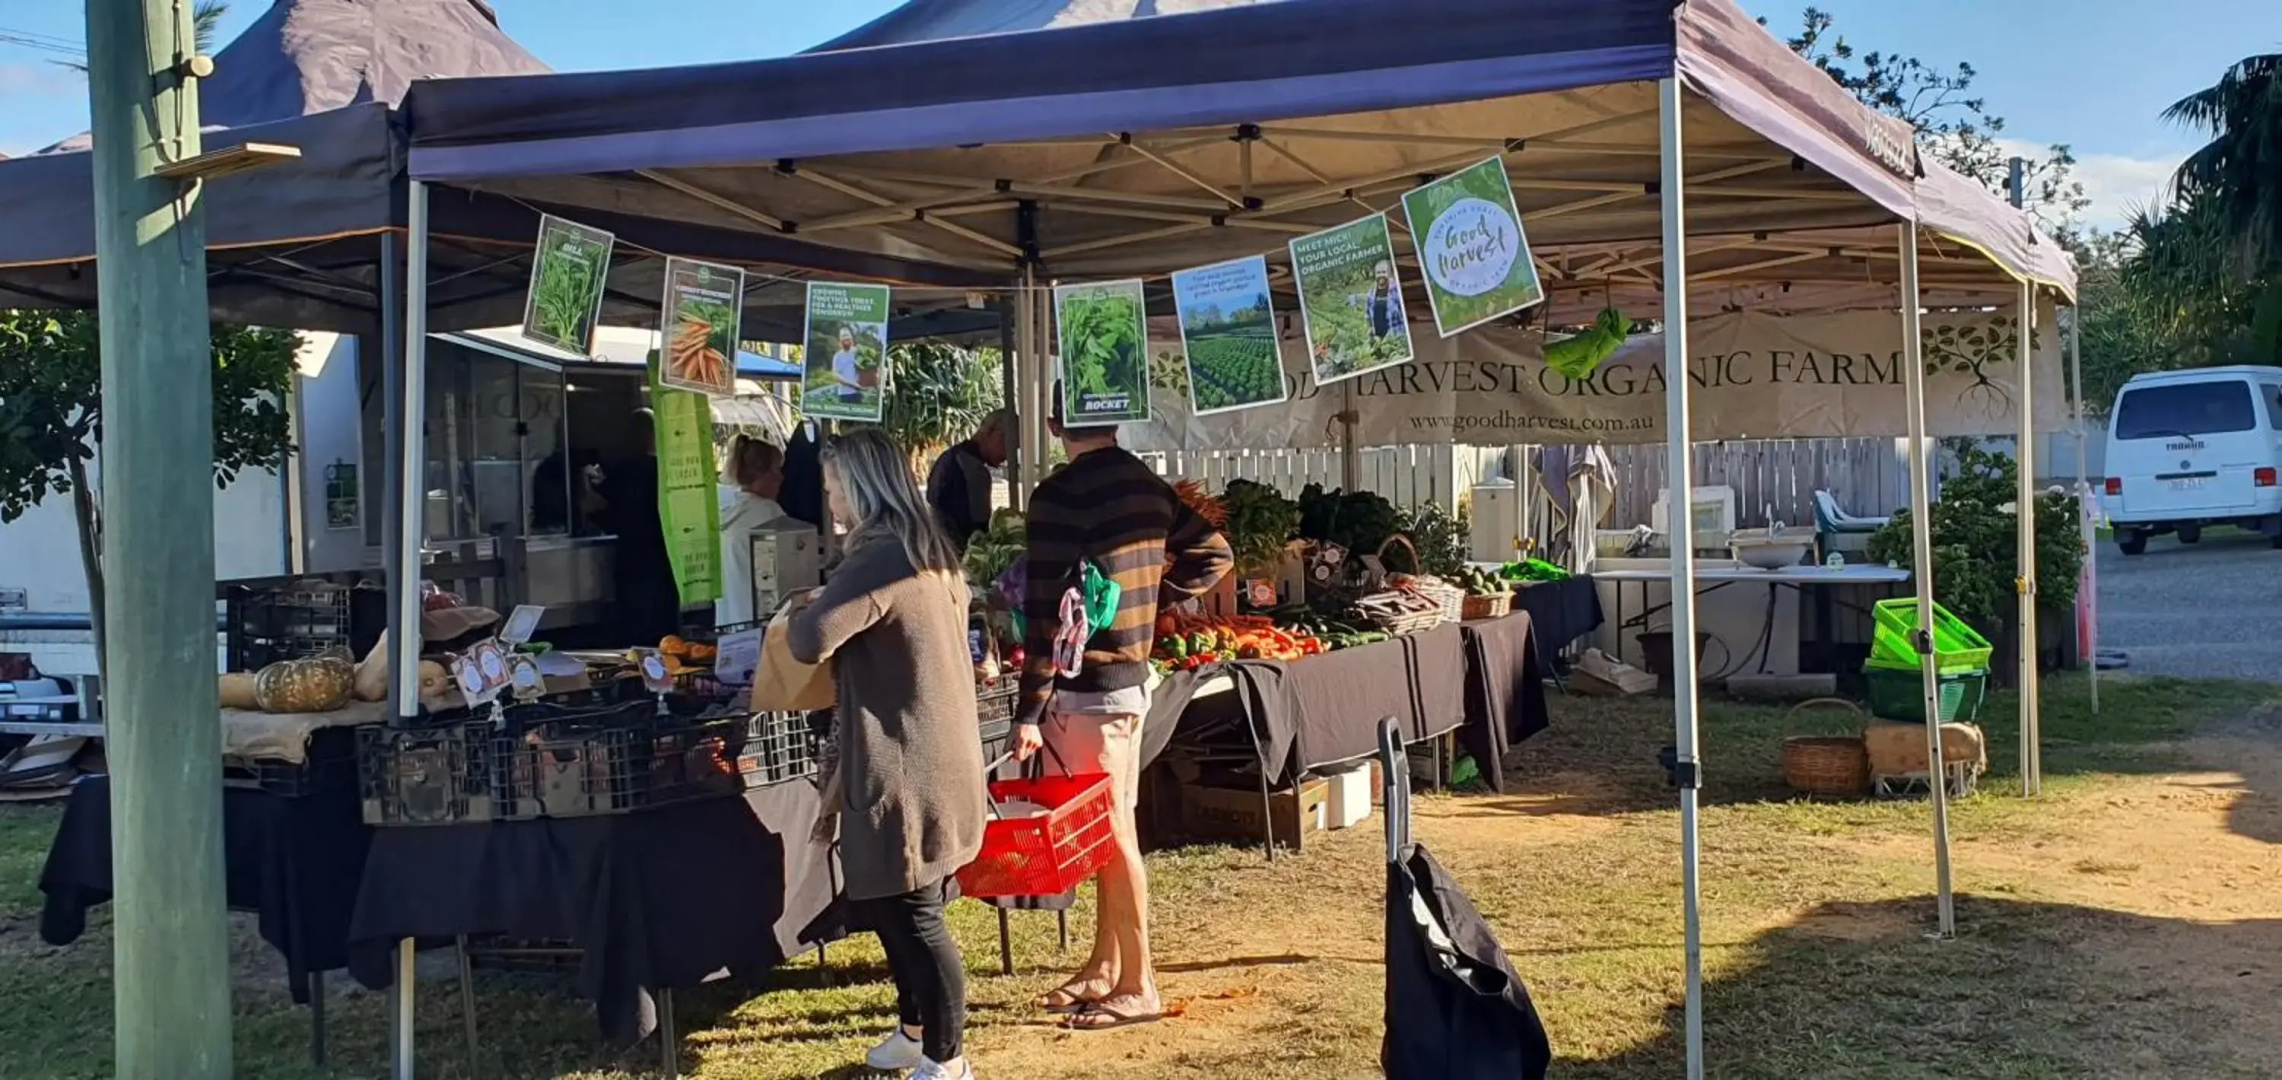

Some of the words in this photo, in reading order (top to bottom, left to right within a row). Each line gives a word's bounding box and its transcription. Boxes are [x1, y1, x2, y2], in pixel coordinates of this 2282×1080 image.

[1445, 213, 1492, 249] Good
[1297, 239, 1322, 253] MEET
[1299, 250, 1326, 265] YOUR
[1301, 256, 1344, 275] ORGANIC
[1346, 244, 1384, 262] FARMER
[1767, 350, 1905, 385] FARM
[1085, 399, 1130, 411] ROCKET
